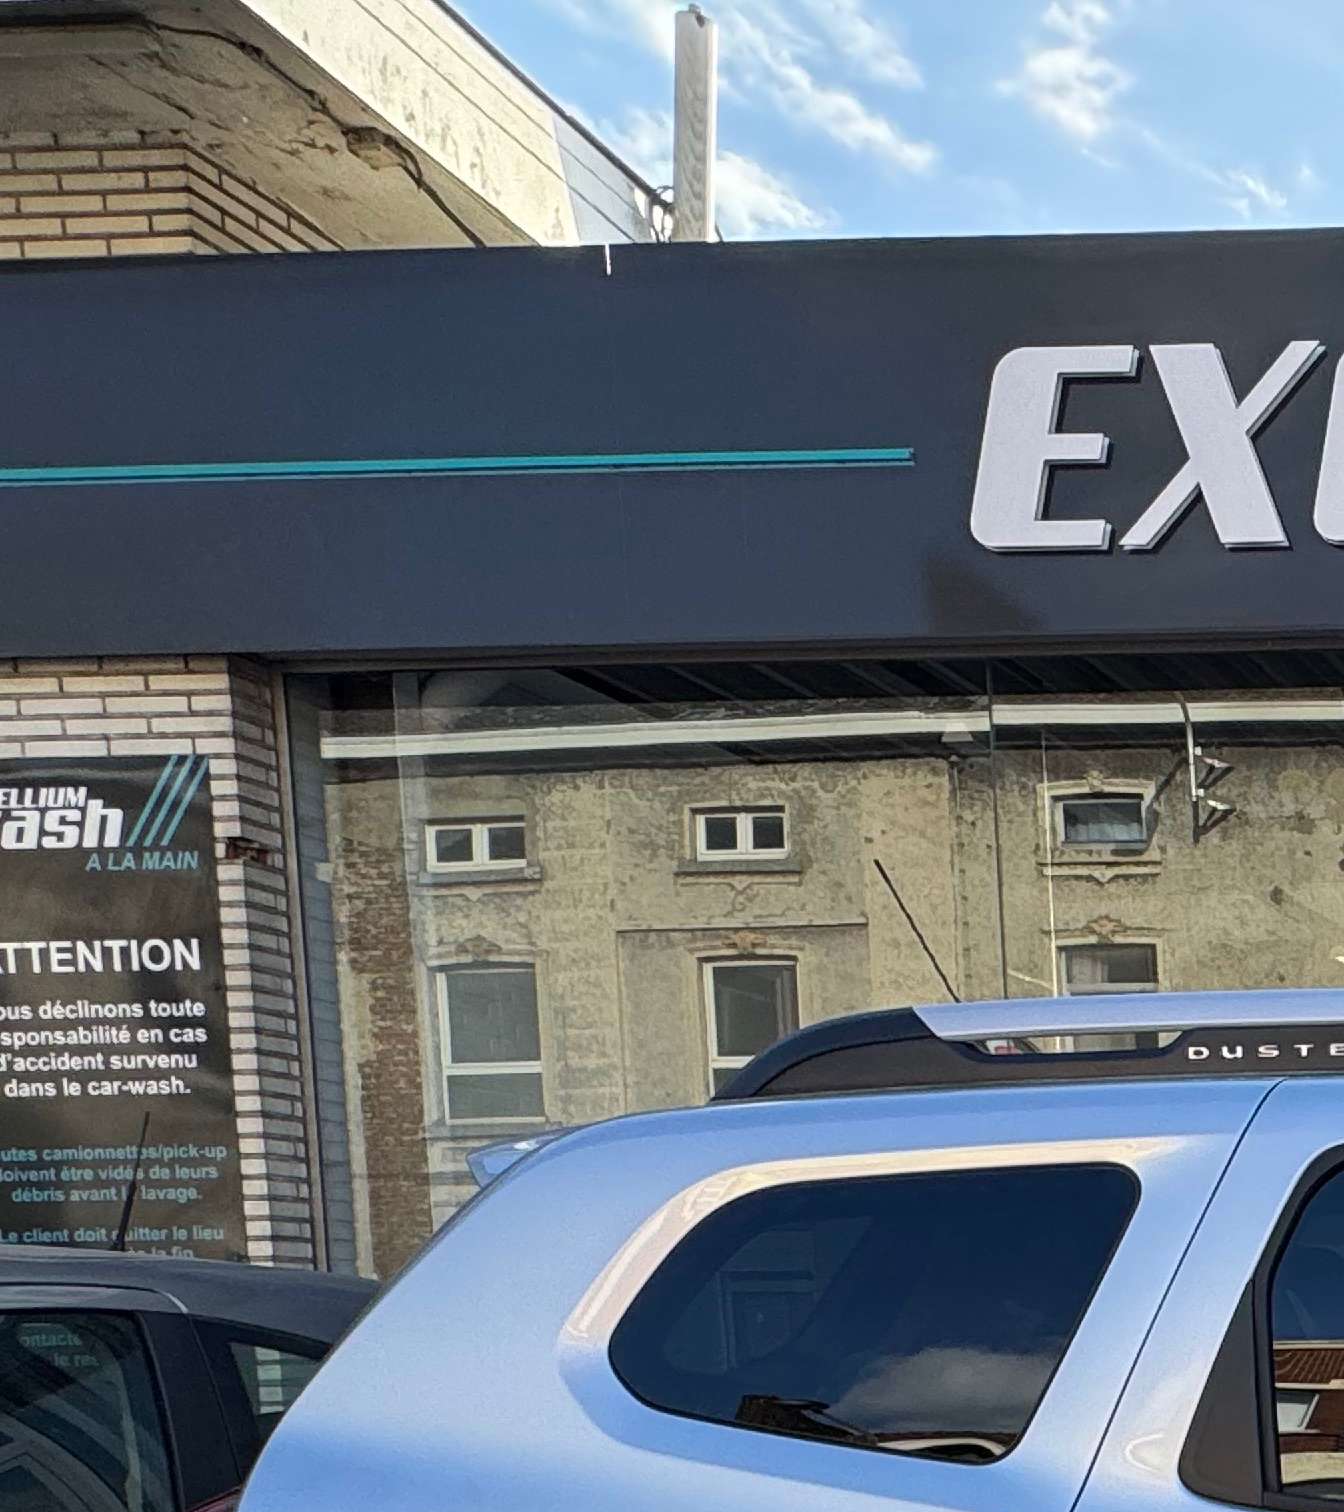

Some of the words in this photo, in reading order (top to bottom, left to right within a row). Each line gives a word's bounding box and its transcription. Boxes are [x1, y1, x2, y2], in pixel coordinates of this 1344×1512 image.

[0, 799, 124, 850] ash
[85, 853, 101, 872] A
[107, 852, 136, 871] LA
[142, 850, 199, 871] MAIN
[0, 938, 200, 975] TTENTION
[38, 1000, 144, 1020] déclinons
[150, 998, 206, 1018] toute
[137, 1029, 164, 1043] en
[169, 1027, 208, 1043] cas
[110, 1053, 198, 1070] survenu
[4, 1078, 57, 1097] dans
[62, 1077, 82, 1096] le
[87, 1075, 191, 1096] car-wash.
[60, 1165, 94, 1181] être
[149, 1165, 170, 1179] de
[175, 1163, 219, 1179] leurs
[11, 1185, 65, 1202] débris
[69, 1187, 117, 1202] avant
[140, 1184, 203, 1203] lavage.
[22, 1226, 69, 1243] client
[74, 1226, 109, 1242] doit
[172, 1225, 188, 1241] le
[193, 1224, 225, 1241] lieu
